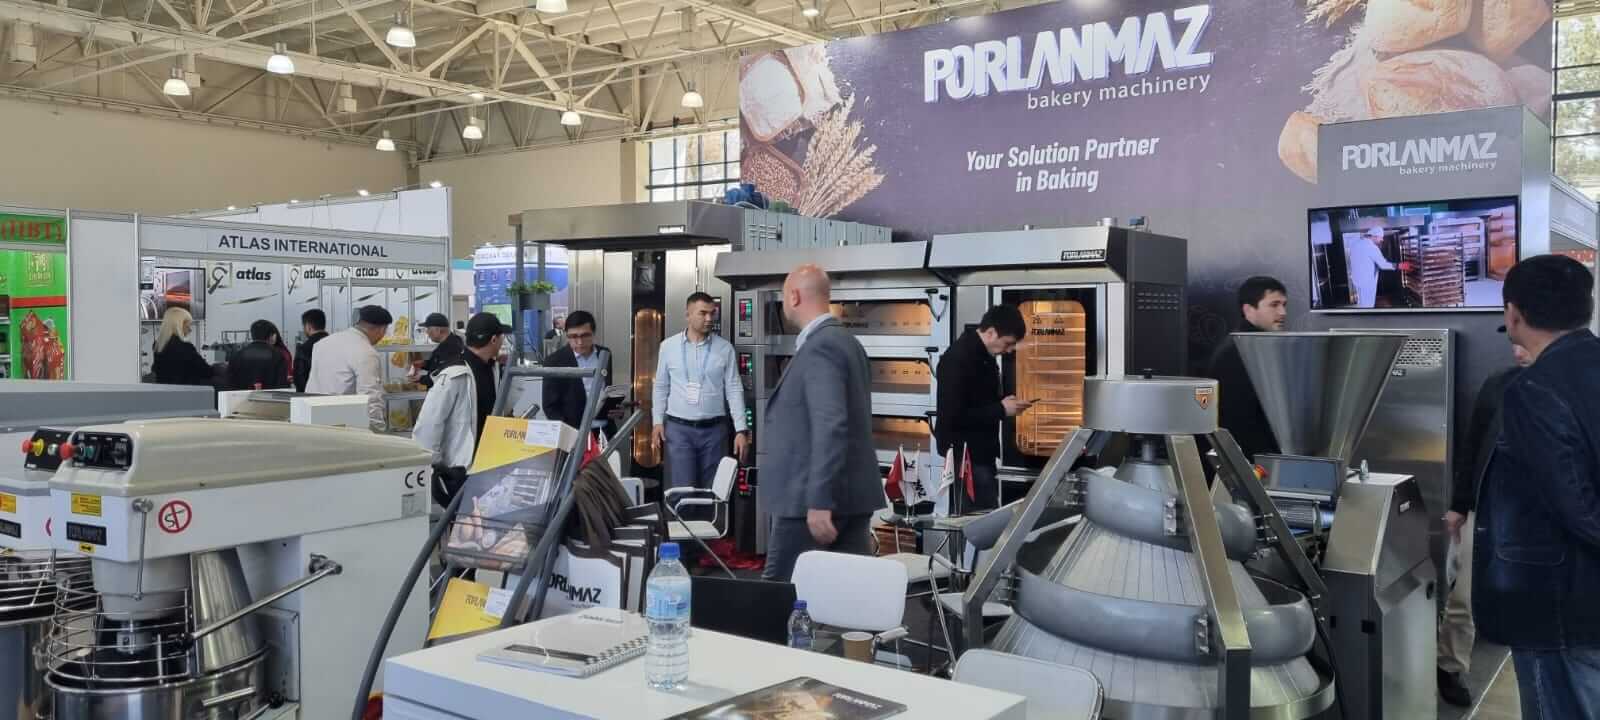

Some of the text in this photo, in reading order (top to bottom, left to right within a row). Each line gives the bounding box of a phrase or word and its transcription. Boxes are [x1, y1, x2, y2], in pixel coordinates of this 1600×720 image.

[924, 4, 1214, 103] PORLANMAZ
[1027, 73, 1211, 110] bakery machinery
[966, 136, 1159, 171] Your Solution Partner
[1342, 132, 1497, 171] PORLANMAZ
[1016, 168, 1099, 192] in Baking
[1399, 160, 1496, 176] bakery machinery
[218, 235, 388, 258] ATLAS INTERNATIONAL
[236, 266, 272, 281] atlas
[303, 263, 326, 279] atlas
